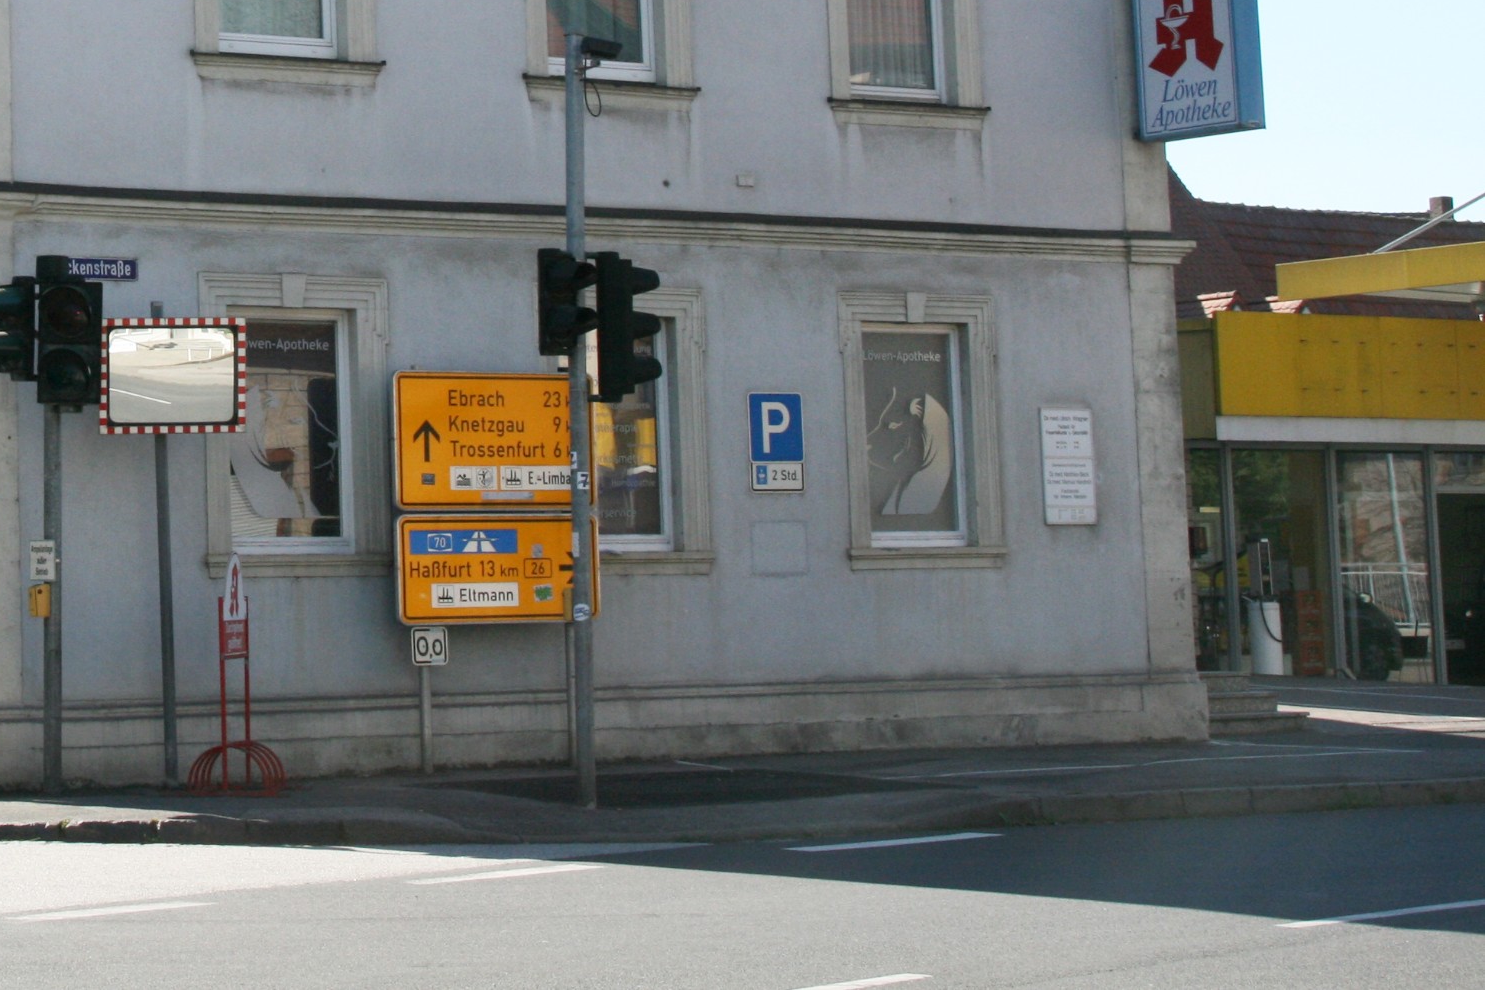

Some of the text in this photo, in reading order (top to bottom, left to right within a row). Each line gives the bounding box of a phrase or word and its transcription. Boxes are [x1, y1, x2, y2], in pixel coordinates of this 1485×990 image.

[1162, 80, 1218, 103] Löwen
[1152, 98, 1231, 132] Apotheke
[68, 259, 131, 277] kenstraße
[246, 338, 330, 352] wen-Apotheke
[448, 389, 505, 407] Ebrach
[543, 391, 561, 408] 23
[448, 415, 525, 436] Knetzgau
[553, 416, 561, 434] 9
[450, 440, 545, 458] Trossenfurt
[553, 441, 562, 458] 6
[528, 471, 571, 485] E.-Limba
[772, 470, 778, 481] 2
[434, 537, 447, 548] 70
[410, 560, 545, 578] Haßfurt 13 km 26
[459, 588, 514, 602] Eltmann
